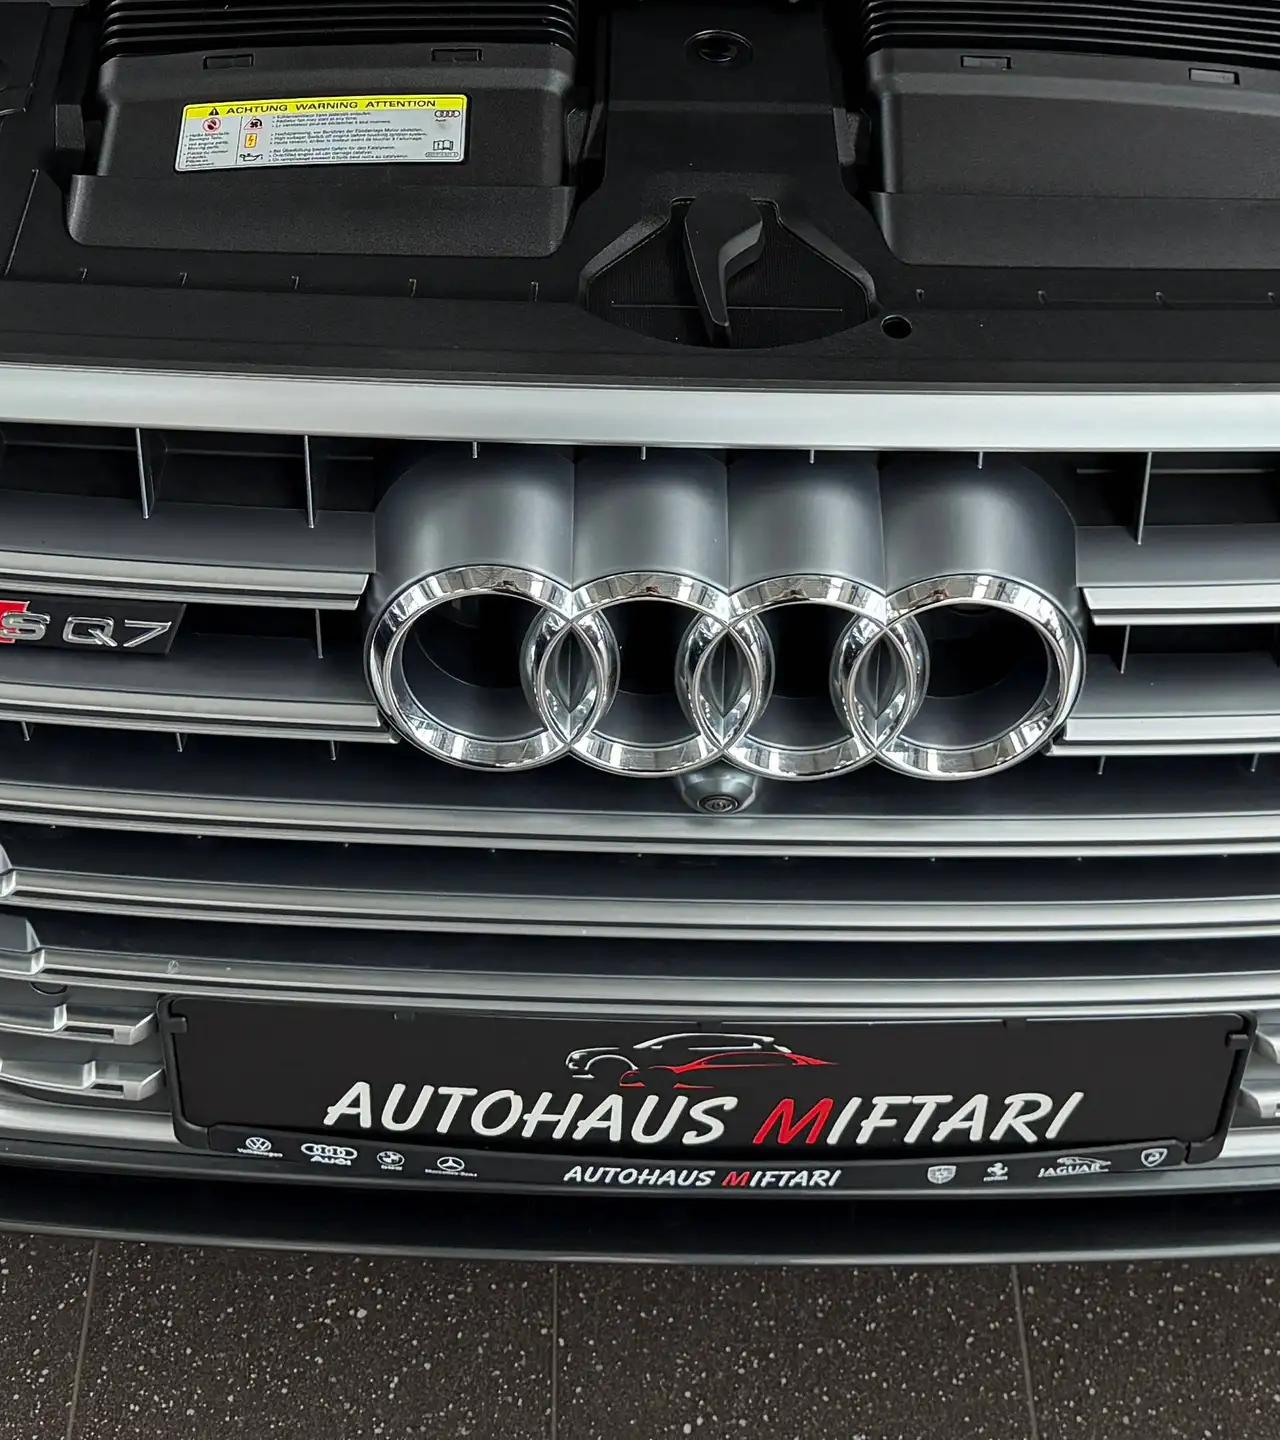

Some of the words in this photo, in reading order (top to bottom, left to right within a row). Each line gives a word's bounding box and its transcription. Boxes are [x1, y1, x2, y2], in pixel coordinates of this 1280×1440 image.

[226, 104, 288, 115] ACHTUNG
[296, 101, 358, 111] WARNING
[365, 100, 436, 108] ATTENTION
[323, 1080, 738, 1146] AUTOHAUS
[751, 1090, 1084, 1146] MIFTARI
[562, 1165, 716, 1187] AUTOHAUS
[721, 1168, 842, 1188] MIFTARI
[1038, 1163, 1109, 1178] JAGUAR
